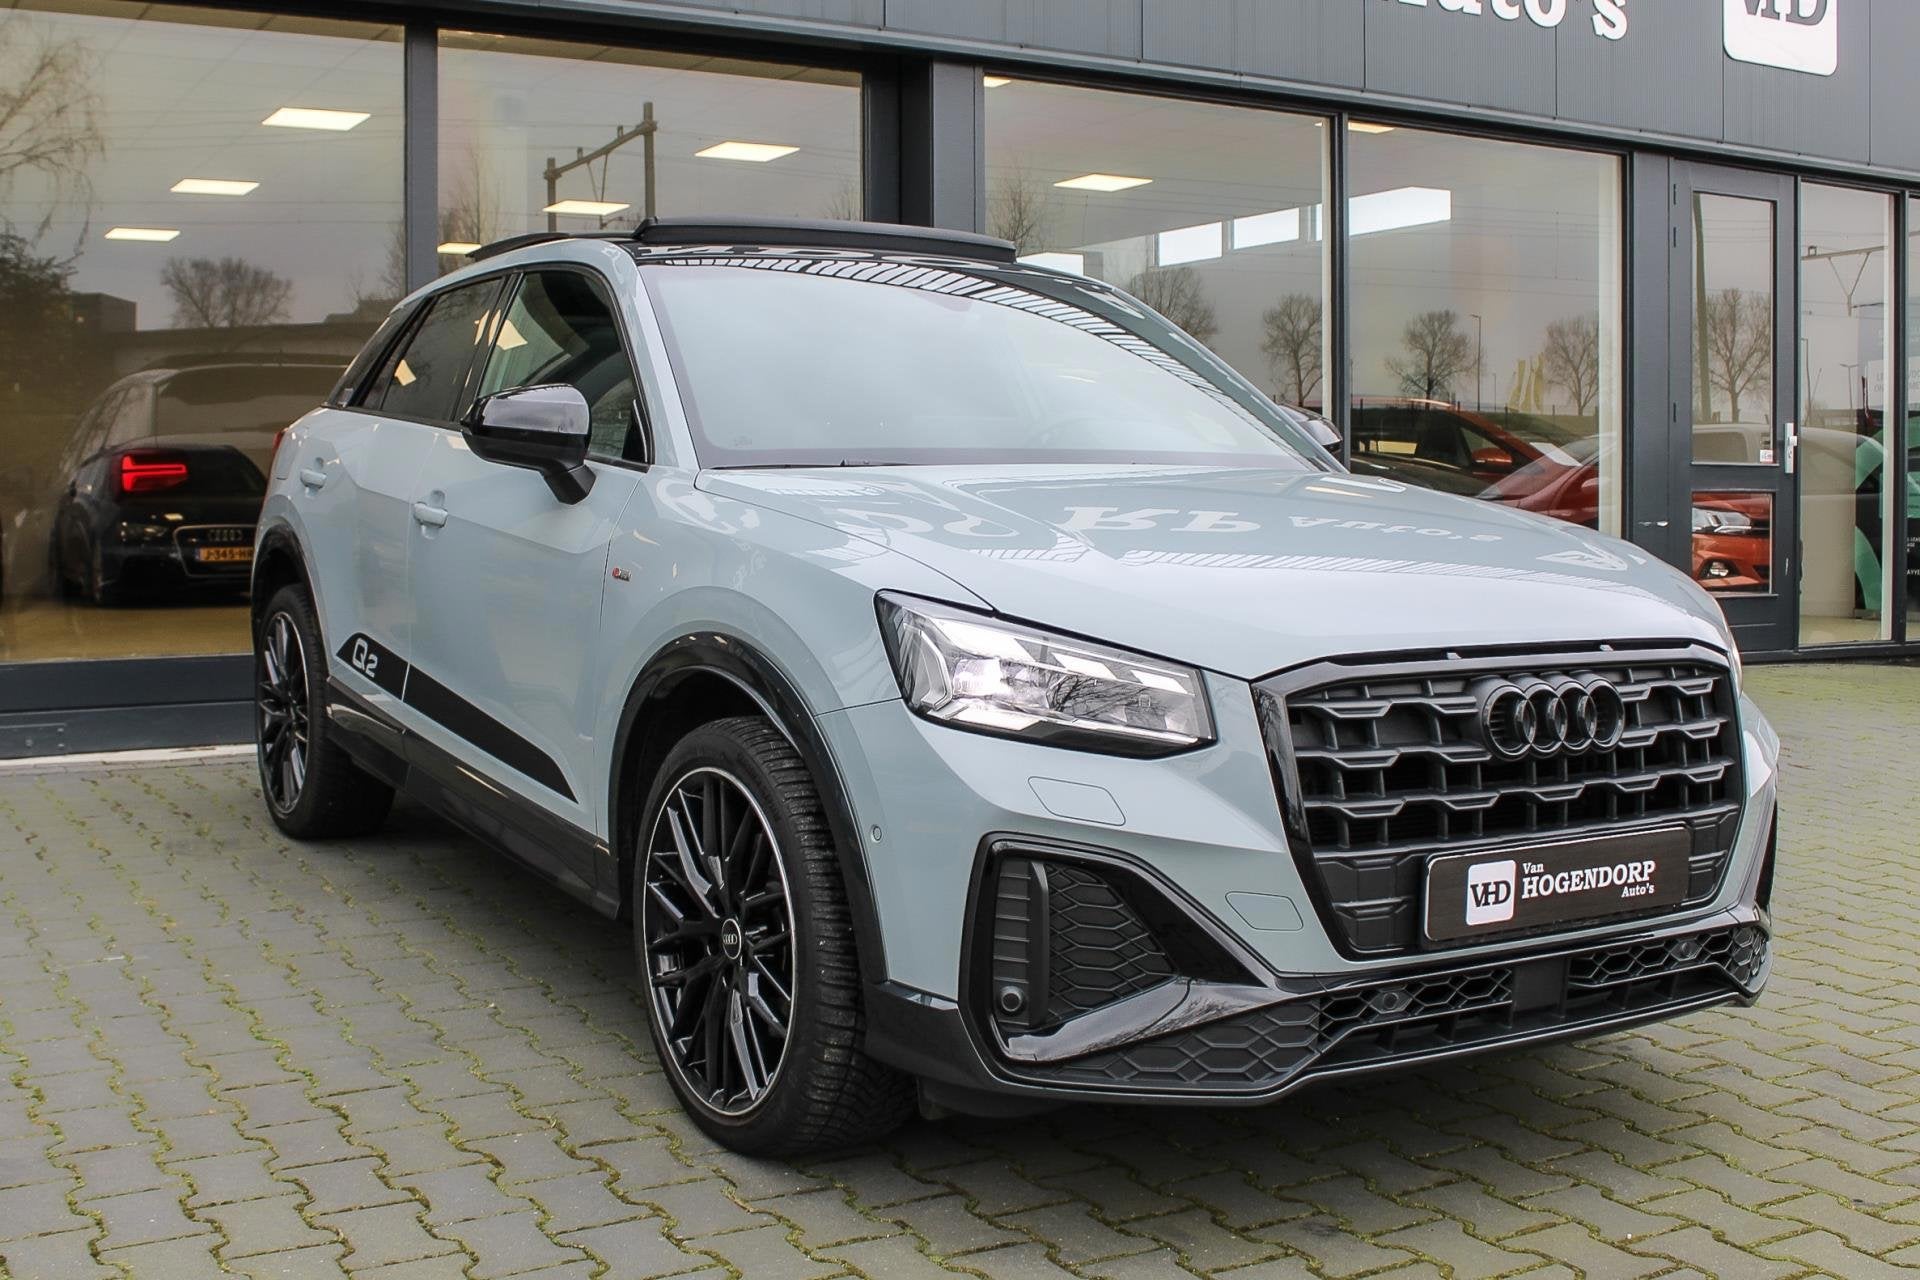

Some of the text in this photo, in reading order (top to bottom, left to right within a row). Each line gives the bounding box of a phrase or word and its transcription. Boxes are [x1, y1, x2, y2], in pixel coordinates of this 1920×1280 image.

[352, 637, 378, 678] Q2
[1521, 860, 1656, 899] HOGENDORP
[1522, 862, 1545, 874] Van
[1621, 883, 1656, 898] Auto's
